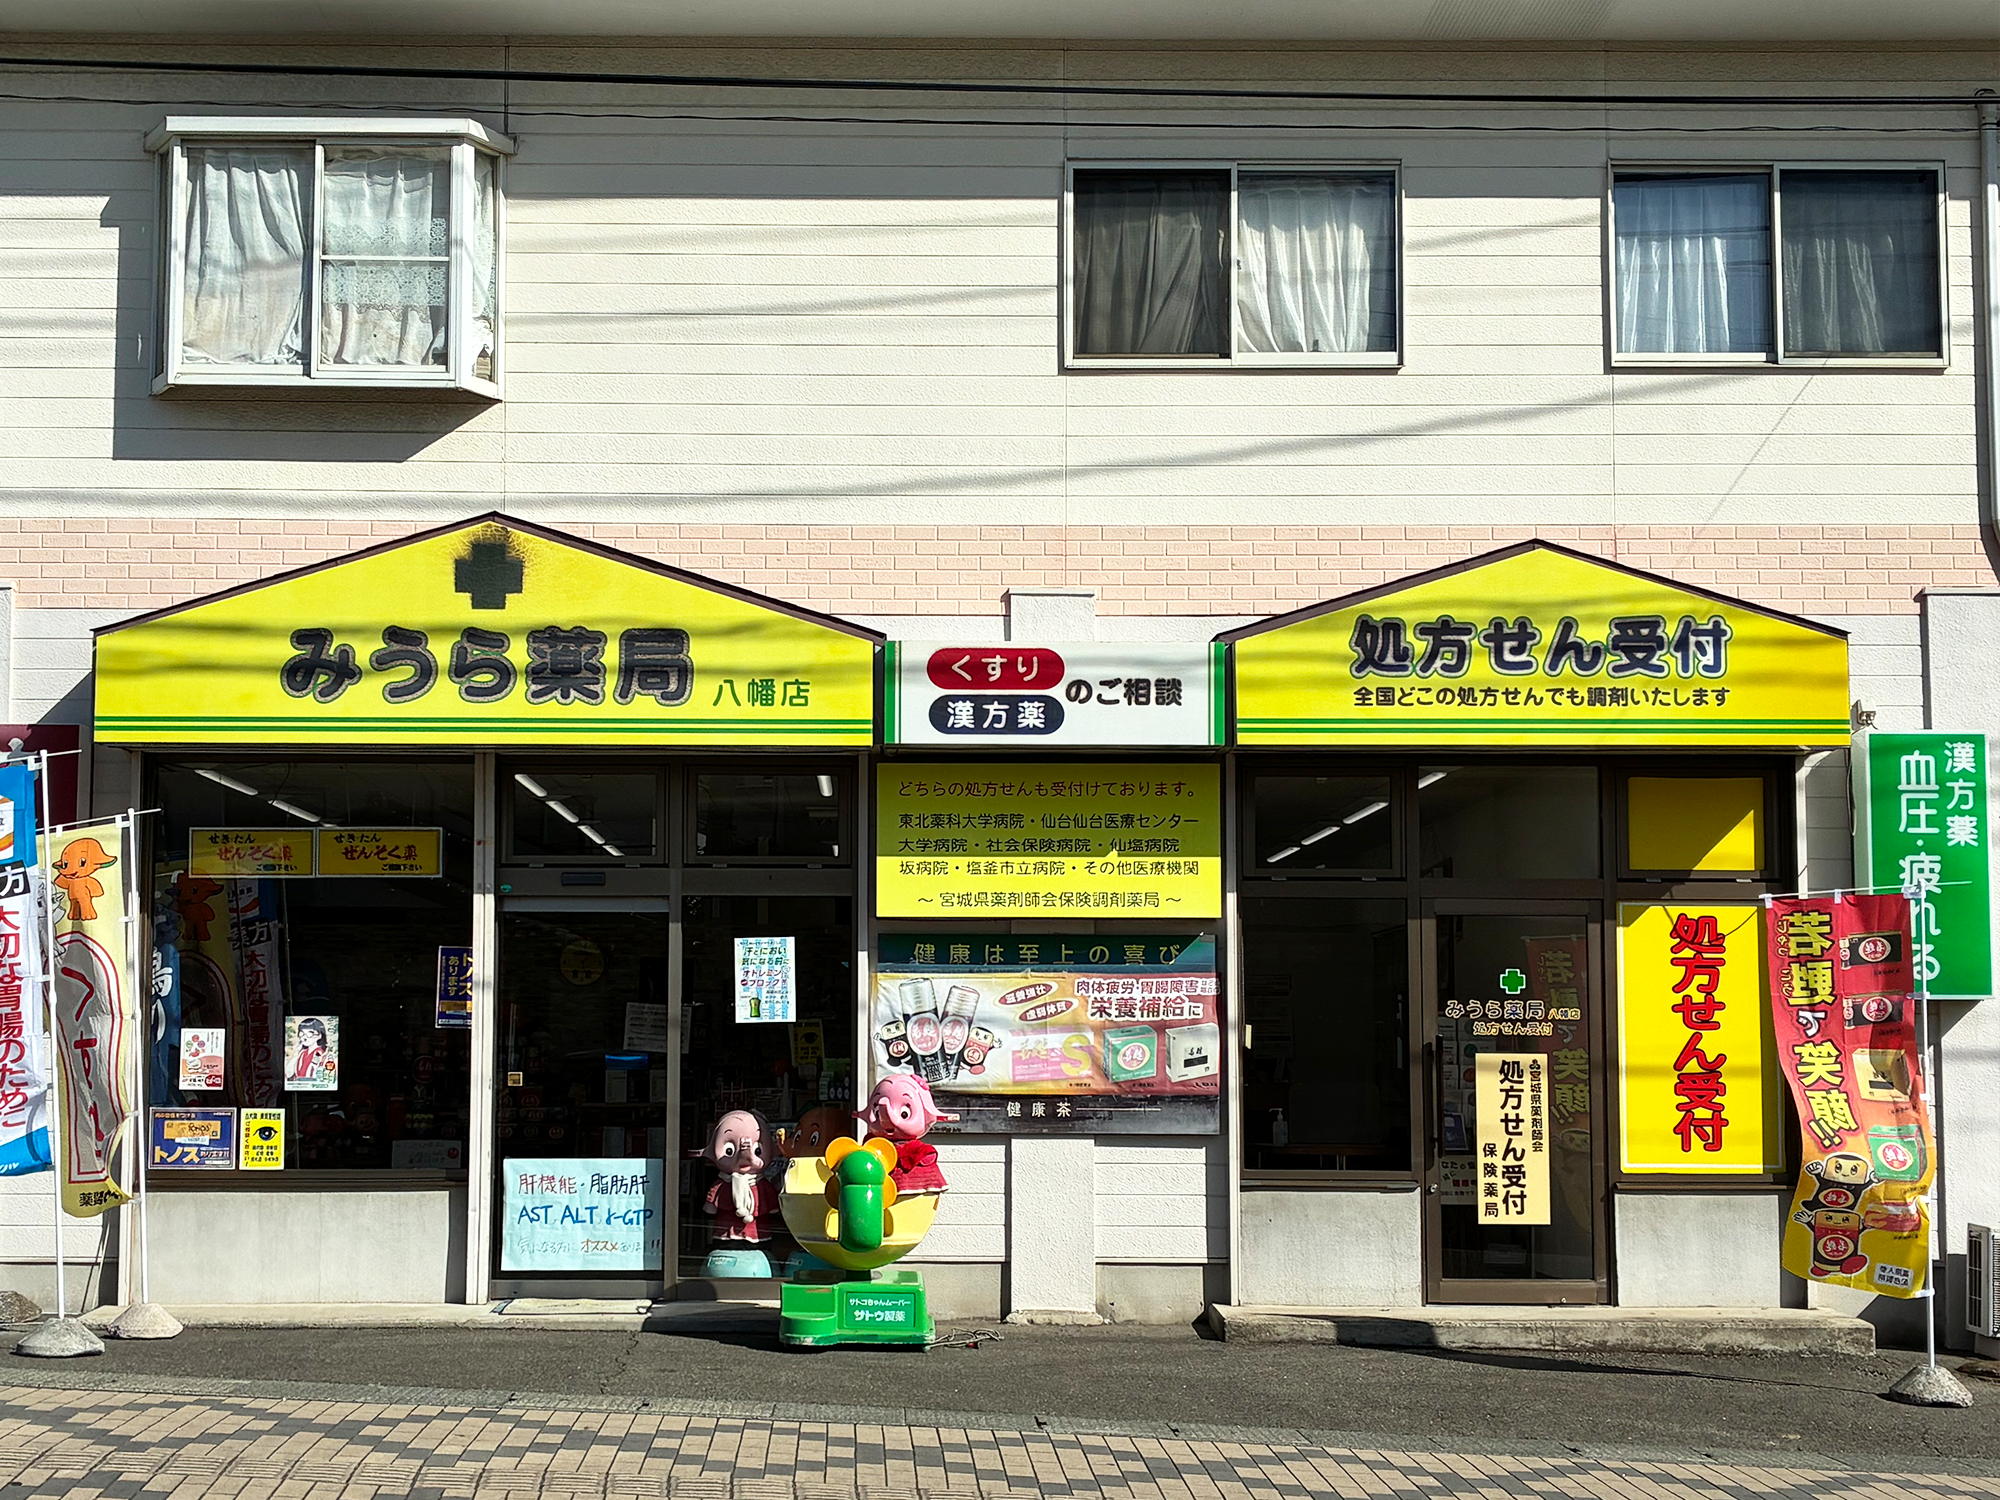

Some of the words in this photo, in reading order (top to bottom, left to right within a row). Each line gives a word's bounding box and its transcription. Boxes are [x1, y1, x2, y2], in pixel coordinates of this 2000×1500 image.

[1350, 614, 1732, 679] 処方せん受付
[280, 626, 694, 706] みうら薬局
[713, 678, 811, 708] 八幡店
[950, 654, 1038, 682] くすり
[1065, 678, 1183, 706] のご相談
[1353, 686, 1731, 707] 全国どこの処方せんでも調剤いたします
[946, 700, 1046, 730] 漢方薬
[898, 781, 1196, 798] どちらの処方せんも受付けております。
[1944, 741, 1979, 847] 漢方薬
[898, 813, 1199, 830] 東北薬科大学病院・仙台仙台医療センター
[341, 845, 418, 861] ぜんそく薬
[898, 837, 1180, 853] 大学病院・社会保険病院・仙塩病院
[899, 861, 1199, 876] 坂病院・塩釜市立病院・その他医療機関
[913, 943, 1183, 965] 健康は至上の喜び
[448, 956, 459, 996] あります
[1090, 996, 1203, 1019] 栄養補給に
[1445, 1000, 1545, 1020] みうら薬局
[1548, 1008, 1580, 1021] 八幡店
[1472, 1022, 1553, 1037] 処方せん受付
[1669, 913, 1730, 1152] 処方せん受付
[1006, 1101, 1072, 1118] 健康茶
[1498, 1059, 1528, 1216] 処方せん受付
[154, 1145, 201, 1164] トノス
[518, 1173, 650, 1195] 肝機能・脂肪肝
[1482, 1142, 1499, 1218] 保険薬局
[854, 1310, 906, 1322] サトウ製薬
